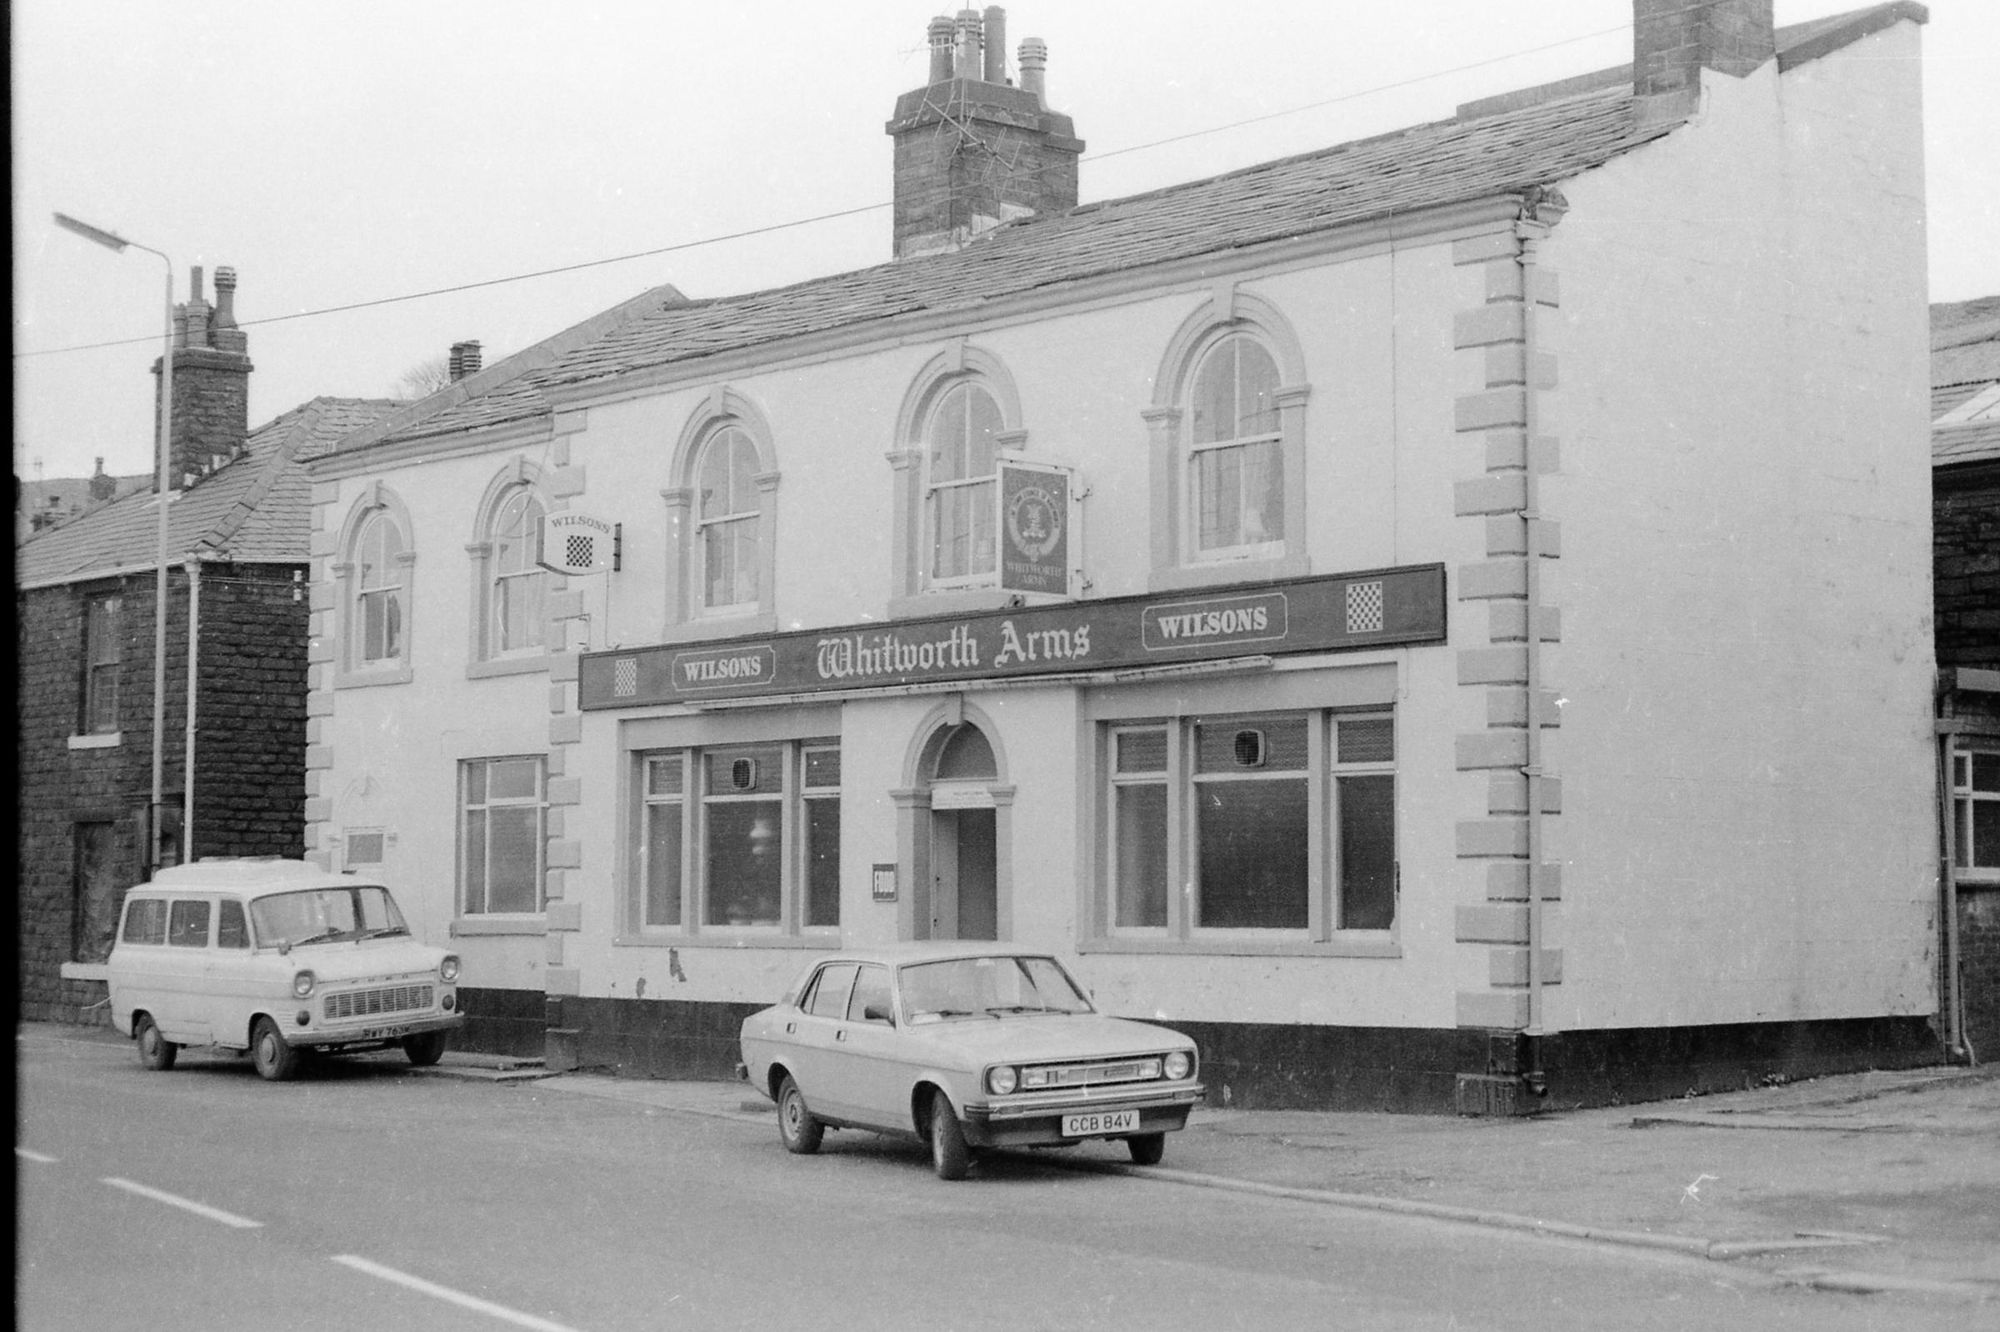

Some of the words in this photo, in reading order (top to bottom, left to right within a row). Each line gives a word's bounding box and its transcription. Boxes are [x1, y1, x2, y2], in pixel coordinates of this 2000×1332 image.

[551, 516, 611, 534] WILSONS
[1157, 606, 1268, 639] WILSONS
[816, 624, 980, 680] Whitworth
[994, 620, 1091, 669] Arms
[683, 655, 762, 682] WILSONS
[1070, 1115, 1099, 1132] CCB
[1103, 1113, 1133, 1130] 84V
